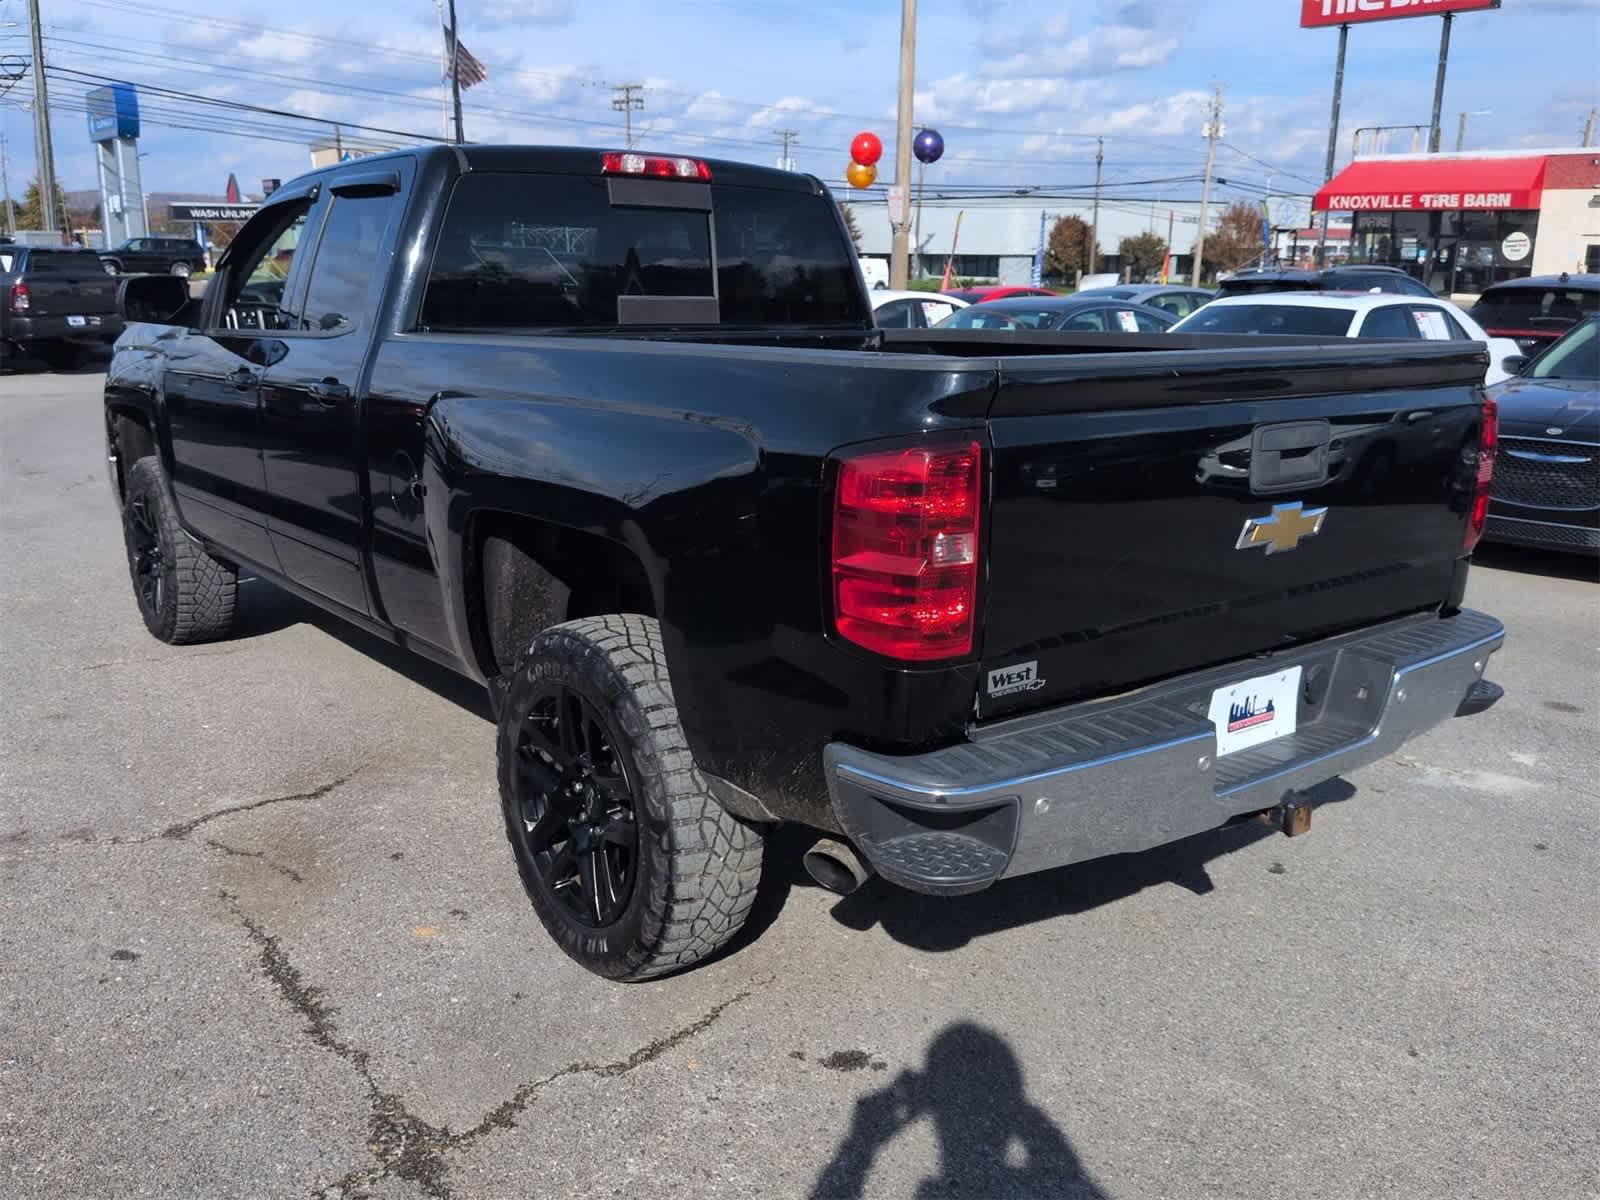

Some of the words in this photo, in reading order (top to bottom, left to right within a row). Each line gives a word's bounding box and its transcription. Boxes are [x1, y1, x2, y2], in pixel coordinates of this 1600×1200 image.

[1329, 194, 1412, 209] KNOXVILLE
[1419, 194, 1460, 208] TIRE
[1463, 193, 1512, 207] BARN
[190, 209, 219, 218] WASH
